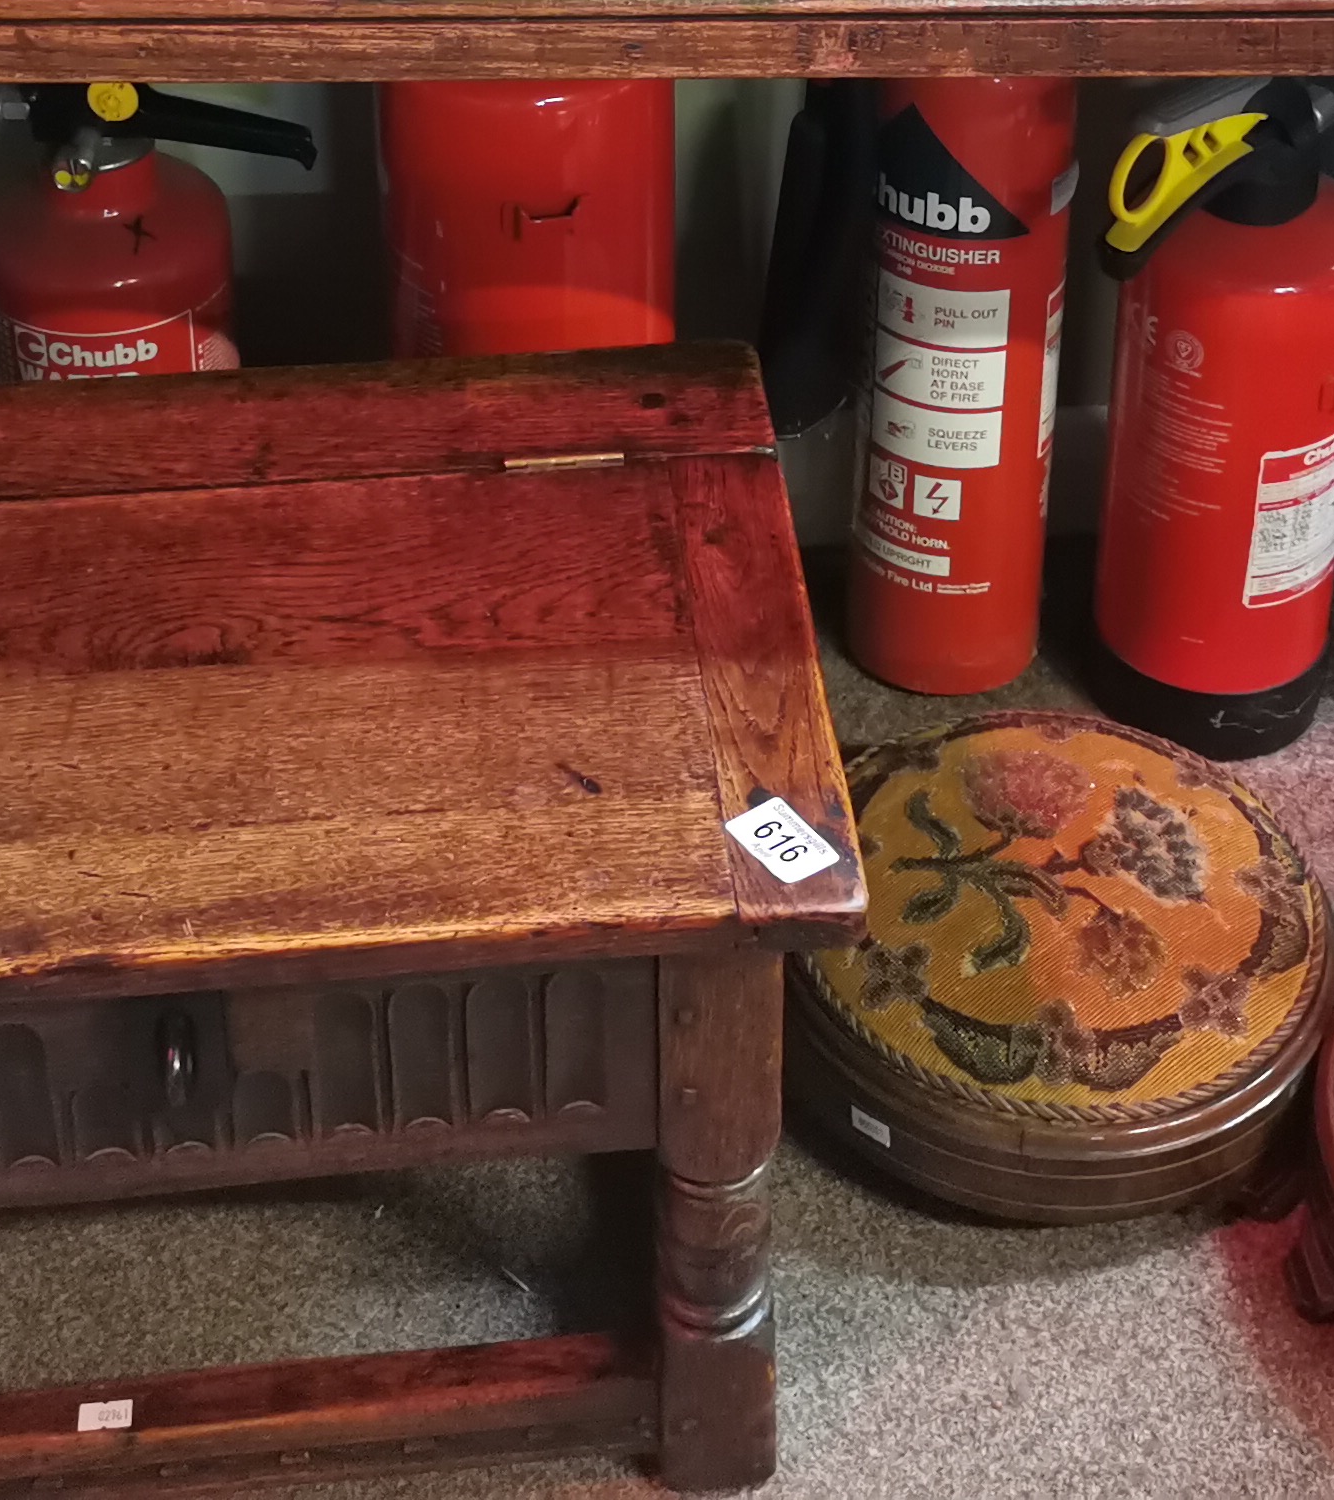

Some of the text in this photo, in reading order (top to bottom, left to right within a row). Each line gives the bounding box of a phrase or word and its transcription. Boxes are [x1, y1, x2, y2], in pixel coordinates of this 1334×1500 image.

[872, 172, 991, 234] hubb
[934, 306, 998, 319] PULL OUT
[933, 318, 955, 329] PIN
[49, 339, 158, 367] Chubb
[931, 356, 980, 369] DIRECT
[931, 368, 969, 380] HORN
[930, 379, 985, 391] AT BASE
[930, 390, 979, 402] OF FIRE
[927, 427, 988, 440] SQUEEZE
[927, 438, 977, 451] LEVERS
[882, 545, 932, 569] UPRIGHT
[911, 578, 932, 593] Ltd
[754, 821, 808, 862] 616
